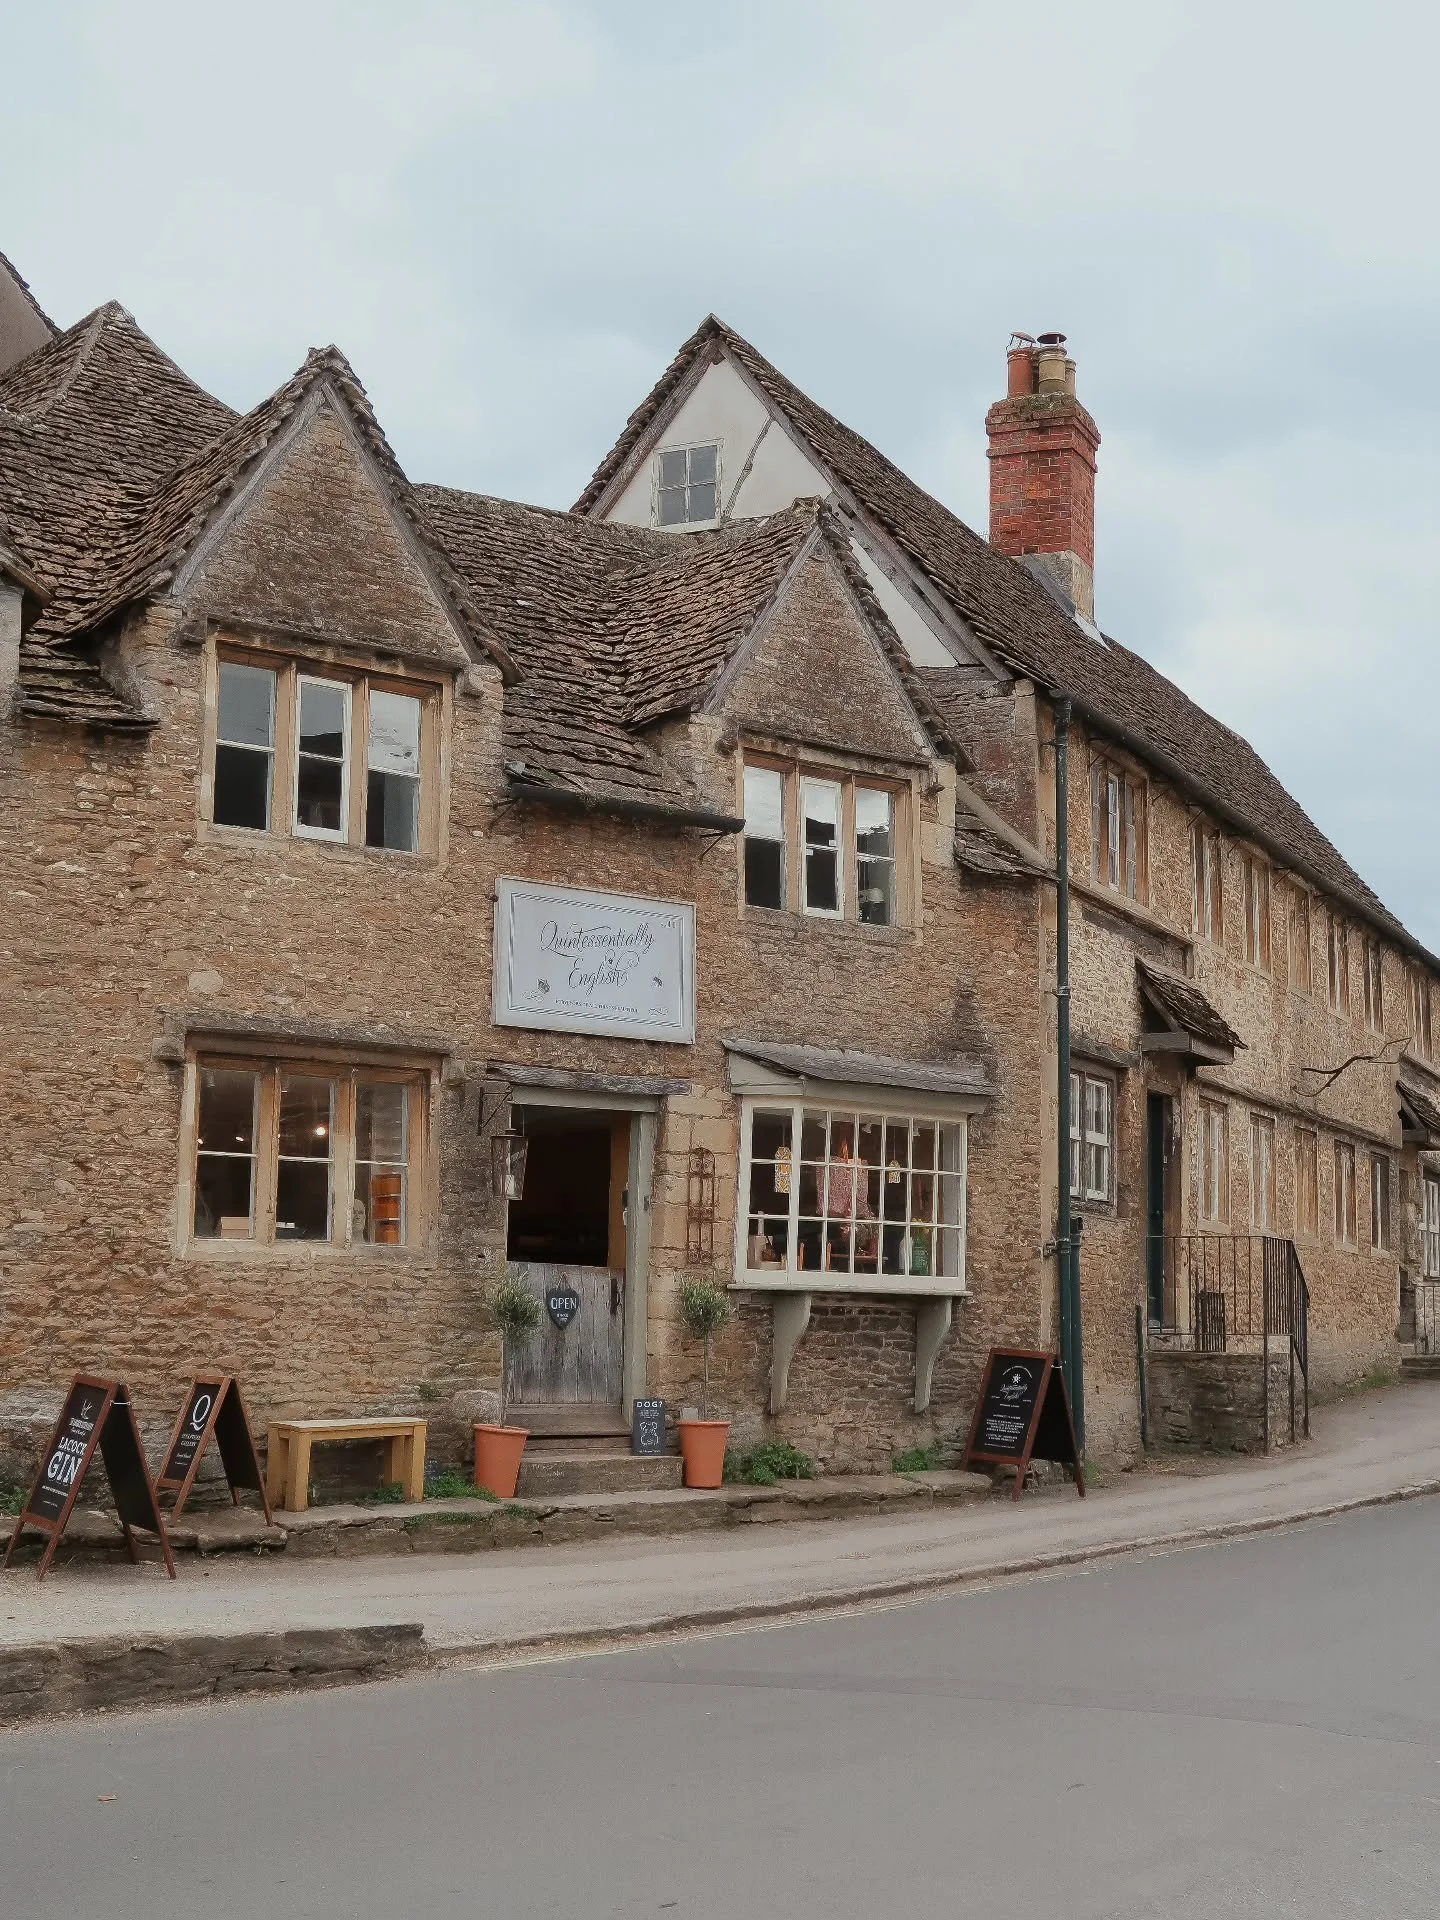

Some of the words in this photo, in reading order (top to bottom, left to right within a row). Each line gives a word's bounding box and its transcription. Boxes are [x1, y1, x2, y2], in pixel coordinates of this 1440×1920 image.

[540, 920, 655, 957] Quintessentially
[568, 950, 639, 996] English
[550, 1297, 577, 1310] OPEN
[189, 1394, 211, 1431] Q
[636, 1400, 663, 1408] DOG?
[58, 1436, 87, 1456] LACOCK
[47, 1450, 83, 1485] GIN
